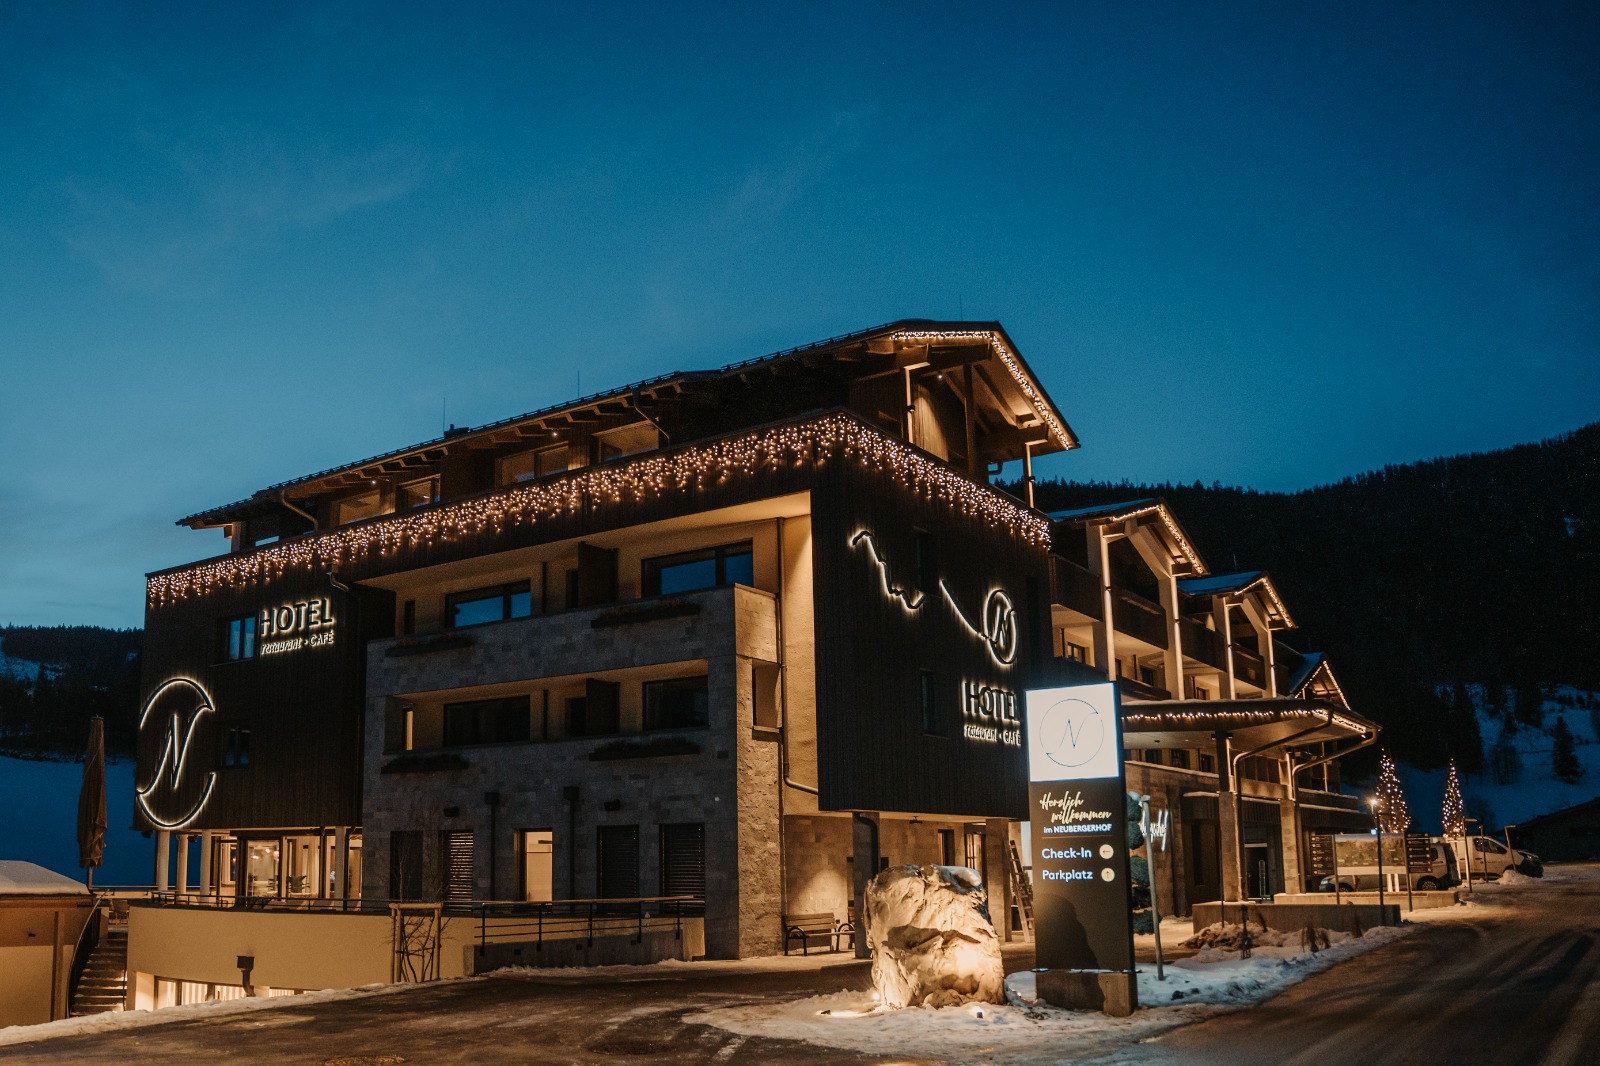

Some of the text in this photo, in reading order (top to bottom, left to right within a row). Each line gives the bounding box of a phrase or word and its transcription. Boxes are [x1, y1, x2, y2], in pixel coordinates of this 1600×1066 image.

[260, 598, 335, 636] HOTEL
[962, 680, 1020, 725] HOTEL
[1040, 791, 1084, 810] Herzlich
[1051, 804, 1112, 824] willkommen
[1043, 823, 1112, 834] im NEUBERGERHOF
[1041, 847, 1092, 859] Check-In
[1042, 869, 1093, 882] Parkplatz
